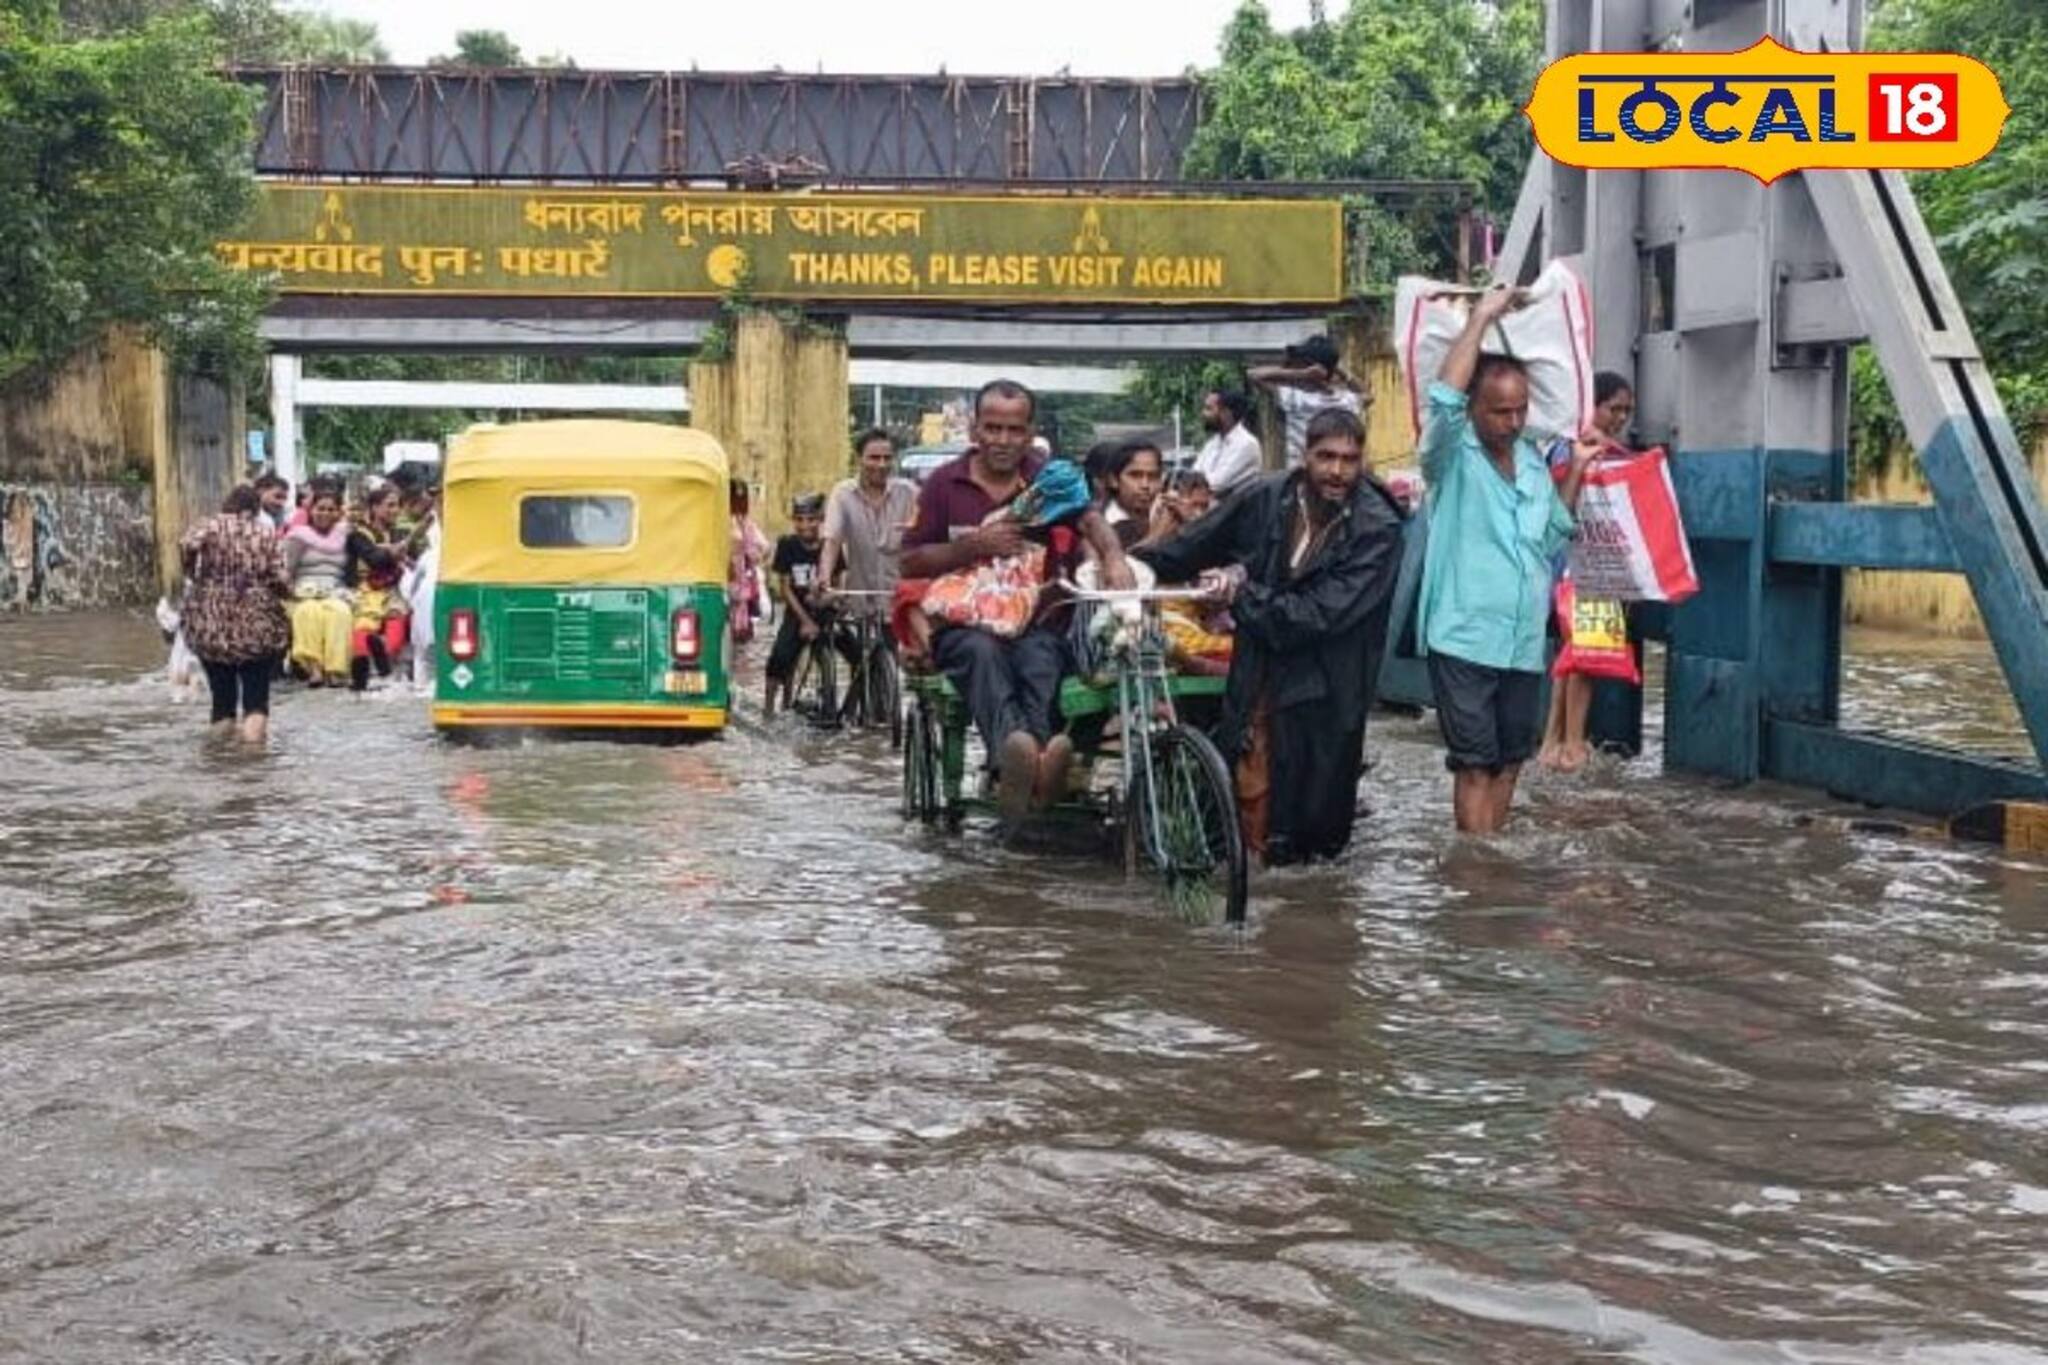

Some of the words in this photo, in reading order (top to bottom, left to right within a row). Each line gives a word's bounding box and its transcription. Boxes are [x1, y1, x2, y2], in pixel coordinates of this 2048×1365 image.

[524, 200, 646, 234] ধন্যবাদ
[661, 200, 775, 247] পুনরায়
[786, 203, 925, 237] আসবেন
[789, 254, 919, 291] THANKS,
[930, 254, 1038, 285] PLEASE
[1048, 256, 1124, 286] VISIT
[1132, 256, 1223, 287] AGAIN
